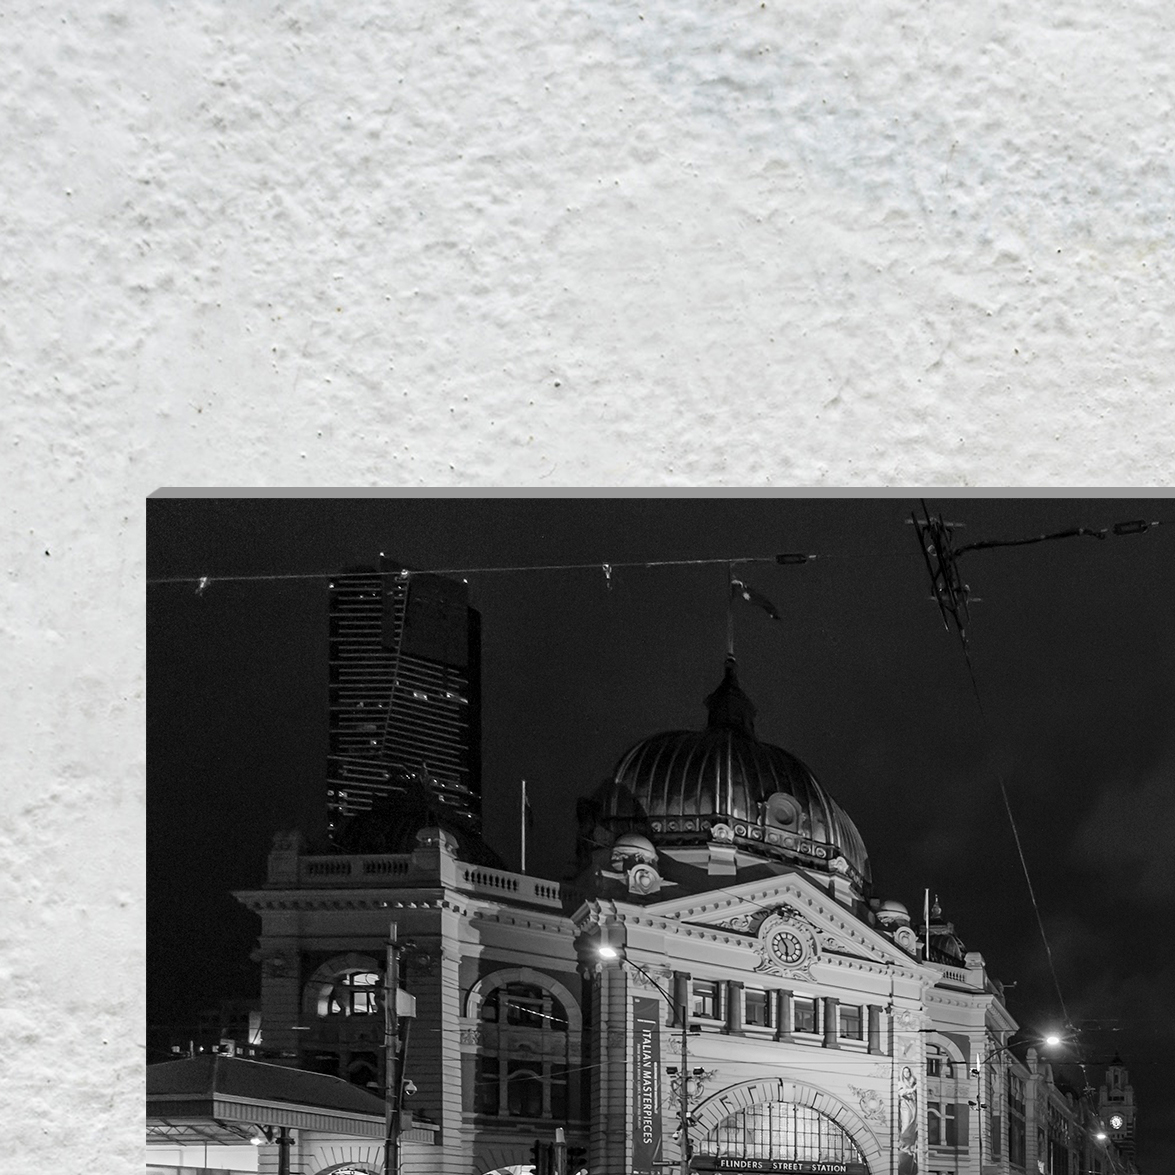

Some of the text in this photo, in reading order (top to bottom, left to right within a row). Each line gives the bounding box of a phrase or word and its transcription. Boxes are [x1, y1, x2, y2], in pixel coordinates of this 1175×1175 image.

[641, 1029, 653, 1145] ITALIAN MASTERPIECES
[720, 1159, 847, 1173] FLINDERS STREET STATION
